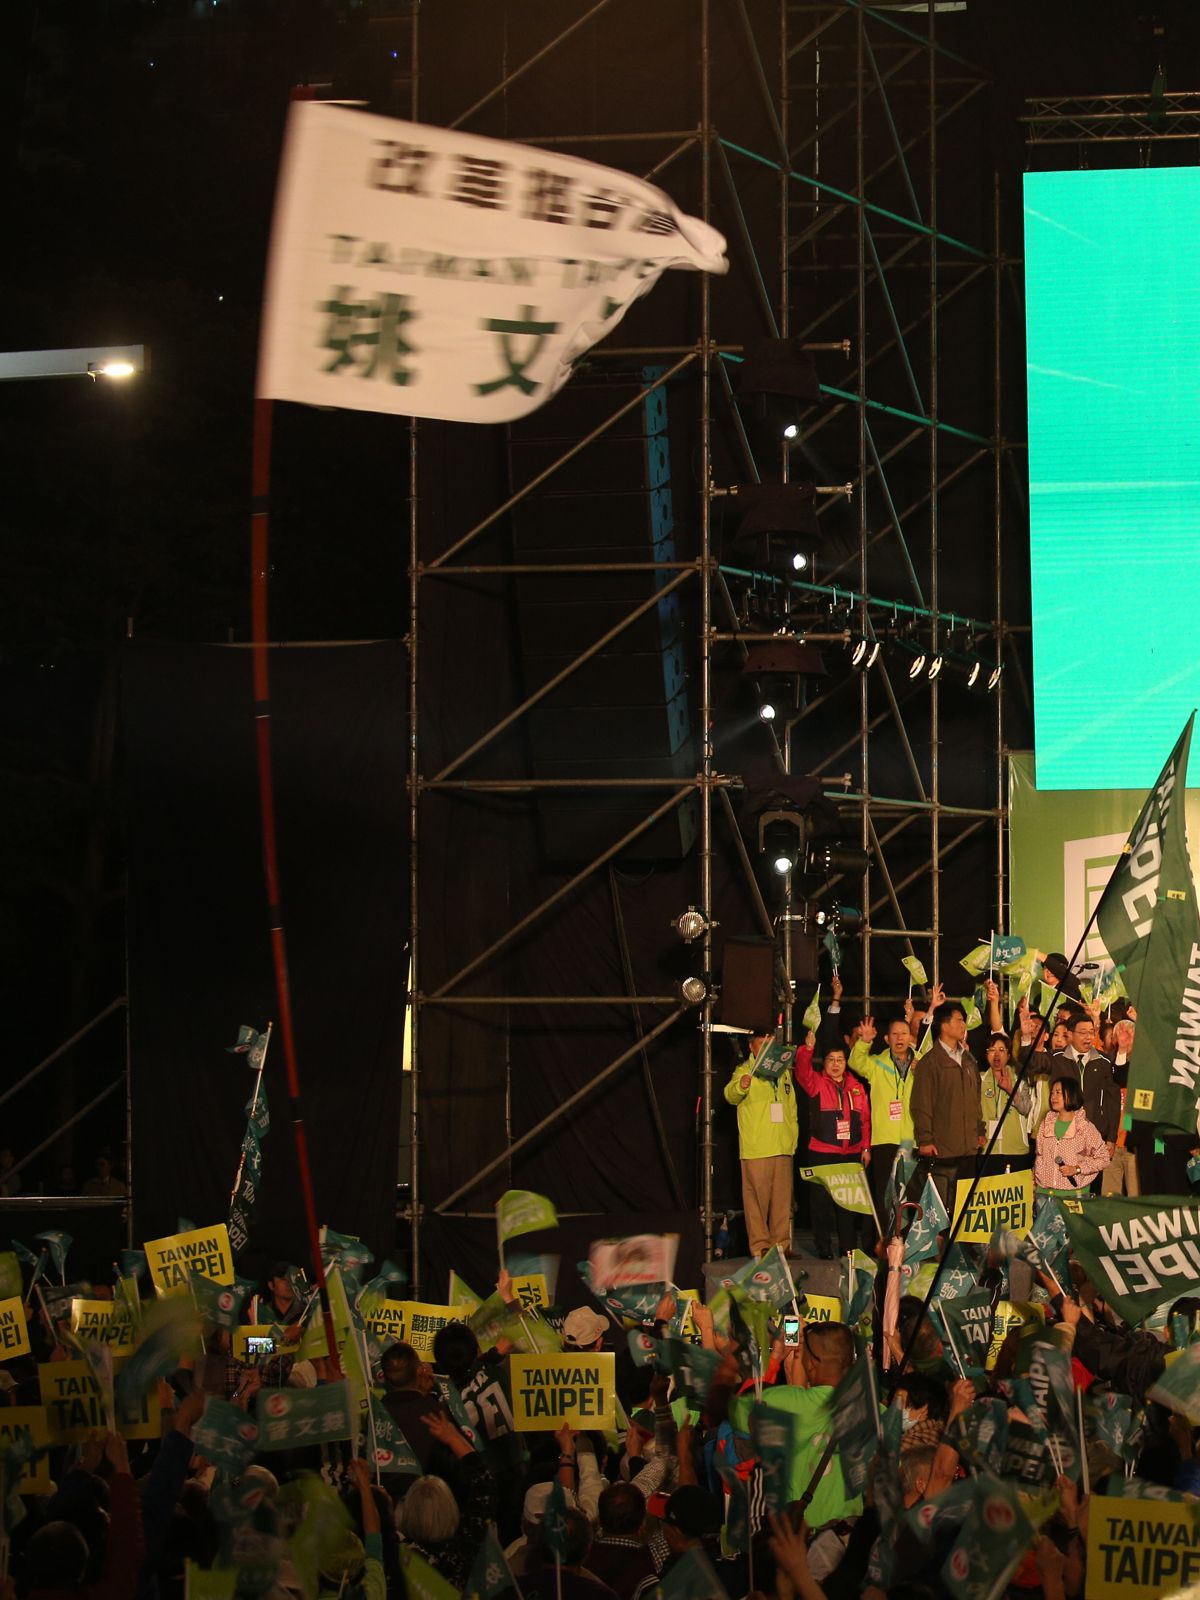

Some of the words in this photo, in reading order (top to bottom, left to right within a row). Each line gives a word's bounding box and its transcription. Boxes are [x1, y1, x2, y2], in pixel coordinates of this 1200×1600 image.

[318, 283, 622, 398] 姚文
[969, 1185, 1025, 1207] TAIWAN
[963, 1203, 1027, 1233] TAIPEI
[157, 1238, 219, 1264] TAIWAN
[961, 1304, 992, 1321] TAIW
[961, 1323, 990, 1344] TAI
[522, 1368, 599, 1386] TAIWAN
[519, 1387, 605, 1417] TAIPEI
